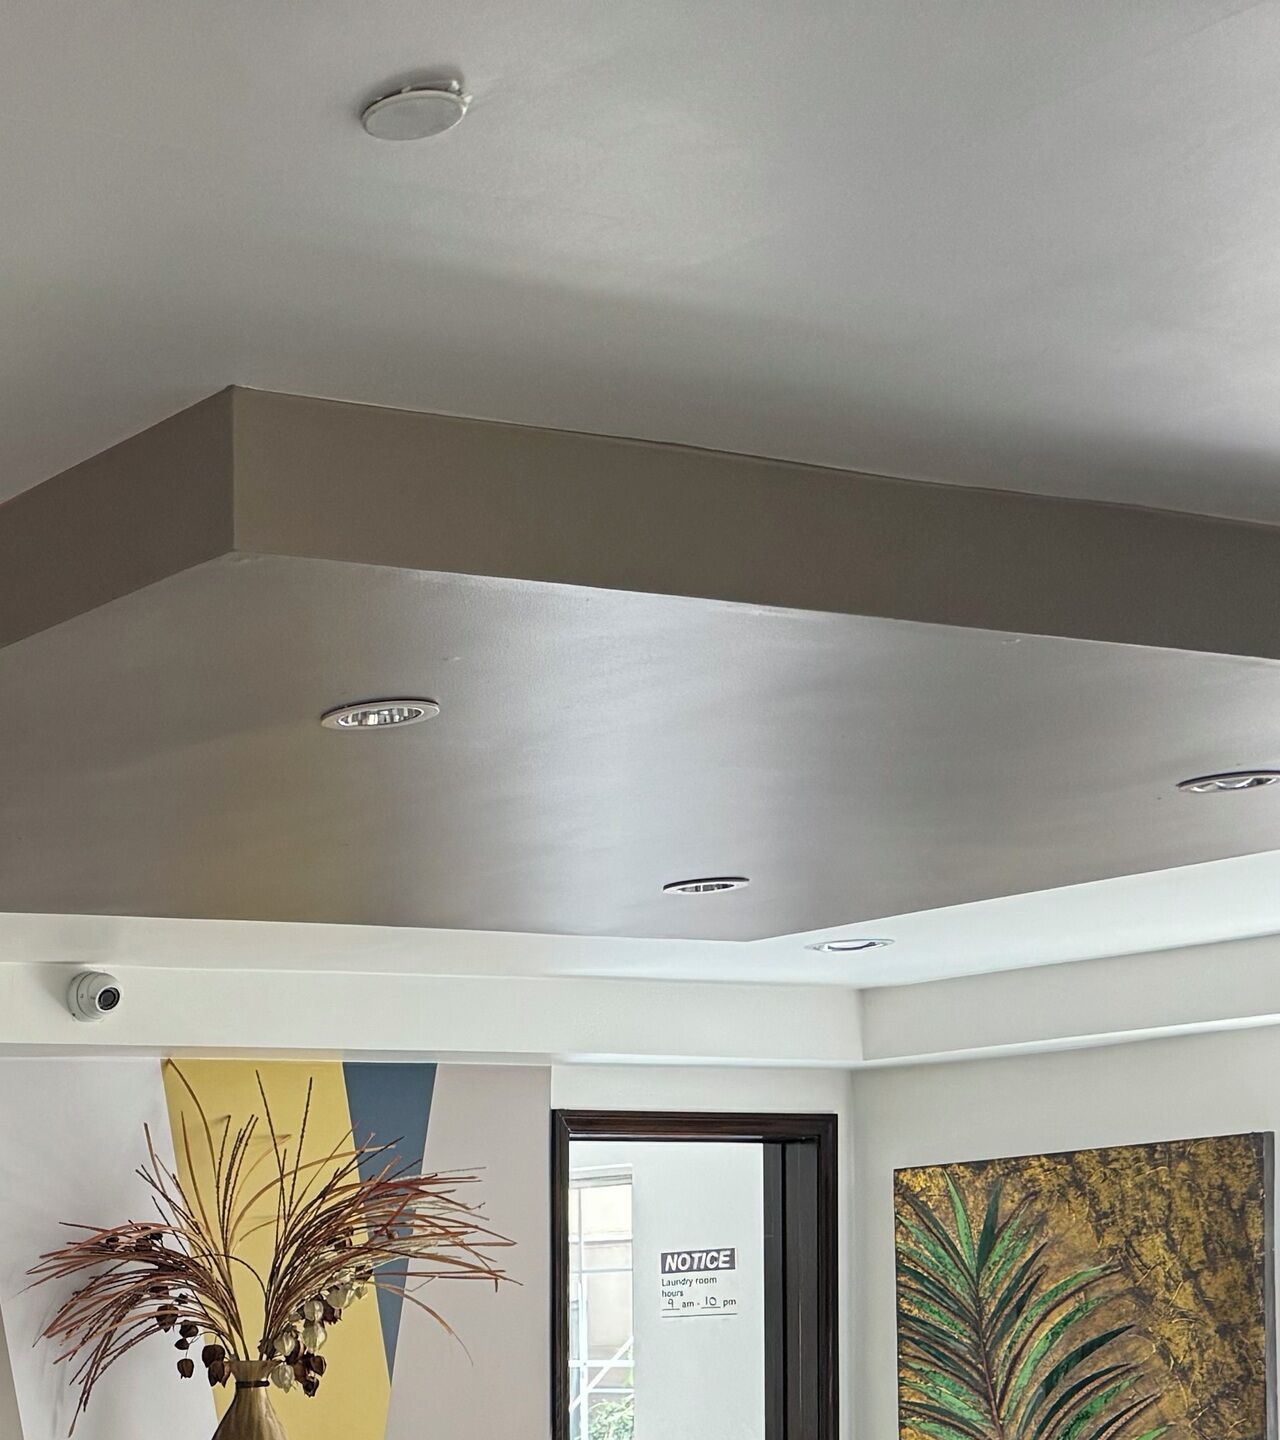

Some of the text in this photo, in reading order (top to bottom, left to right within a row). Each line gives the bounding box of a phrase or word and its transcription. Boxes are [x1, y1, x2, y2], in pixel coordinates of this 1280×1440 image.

[665, 1250, 731, 1272] NOTICE
[661, 1276, 717, 1287] Laundry room
[662, 1290, 684, 1298] hours
[723, 1298, 737, 1307] pm
